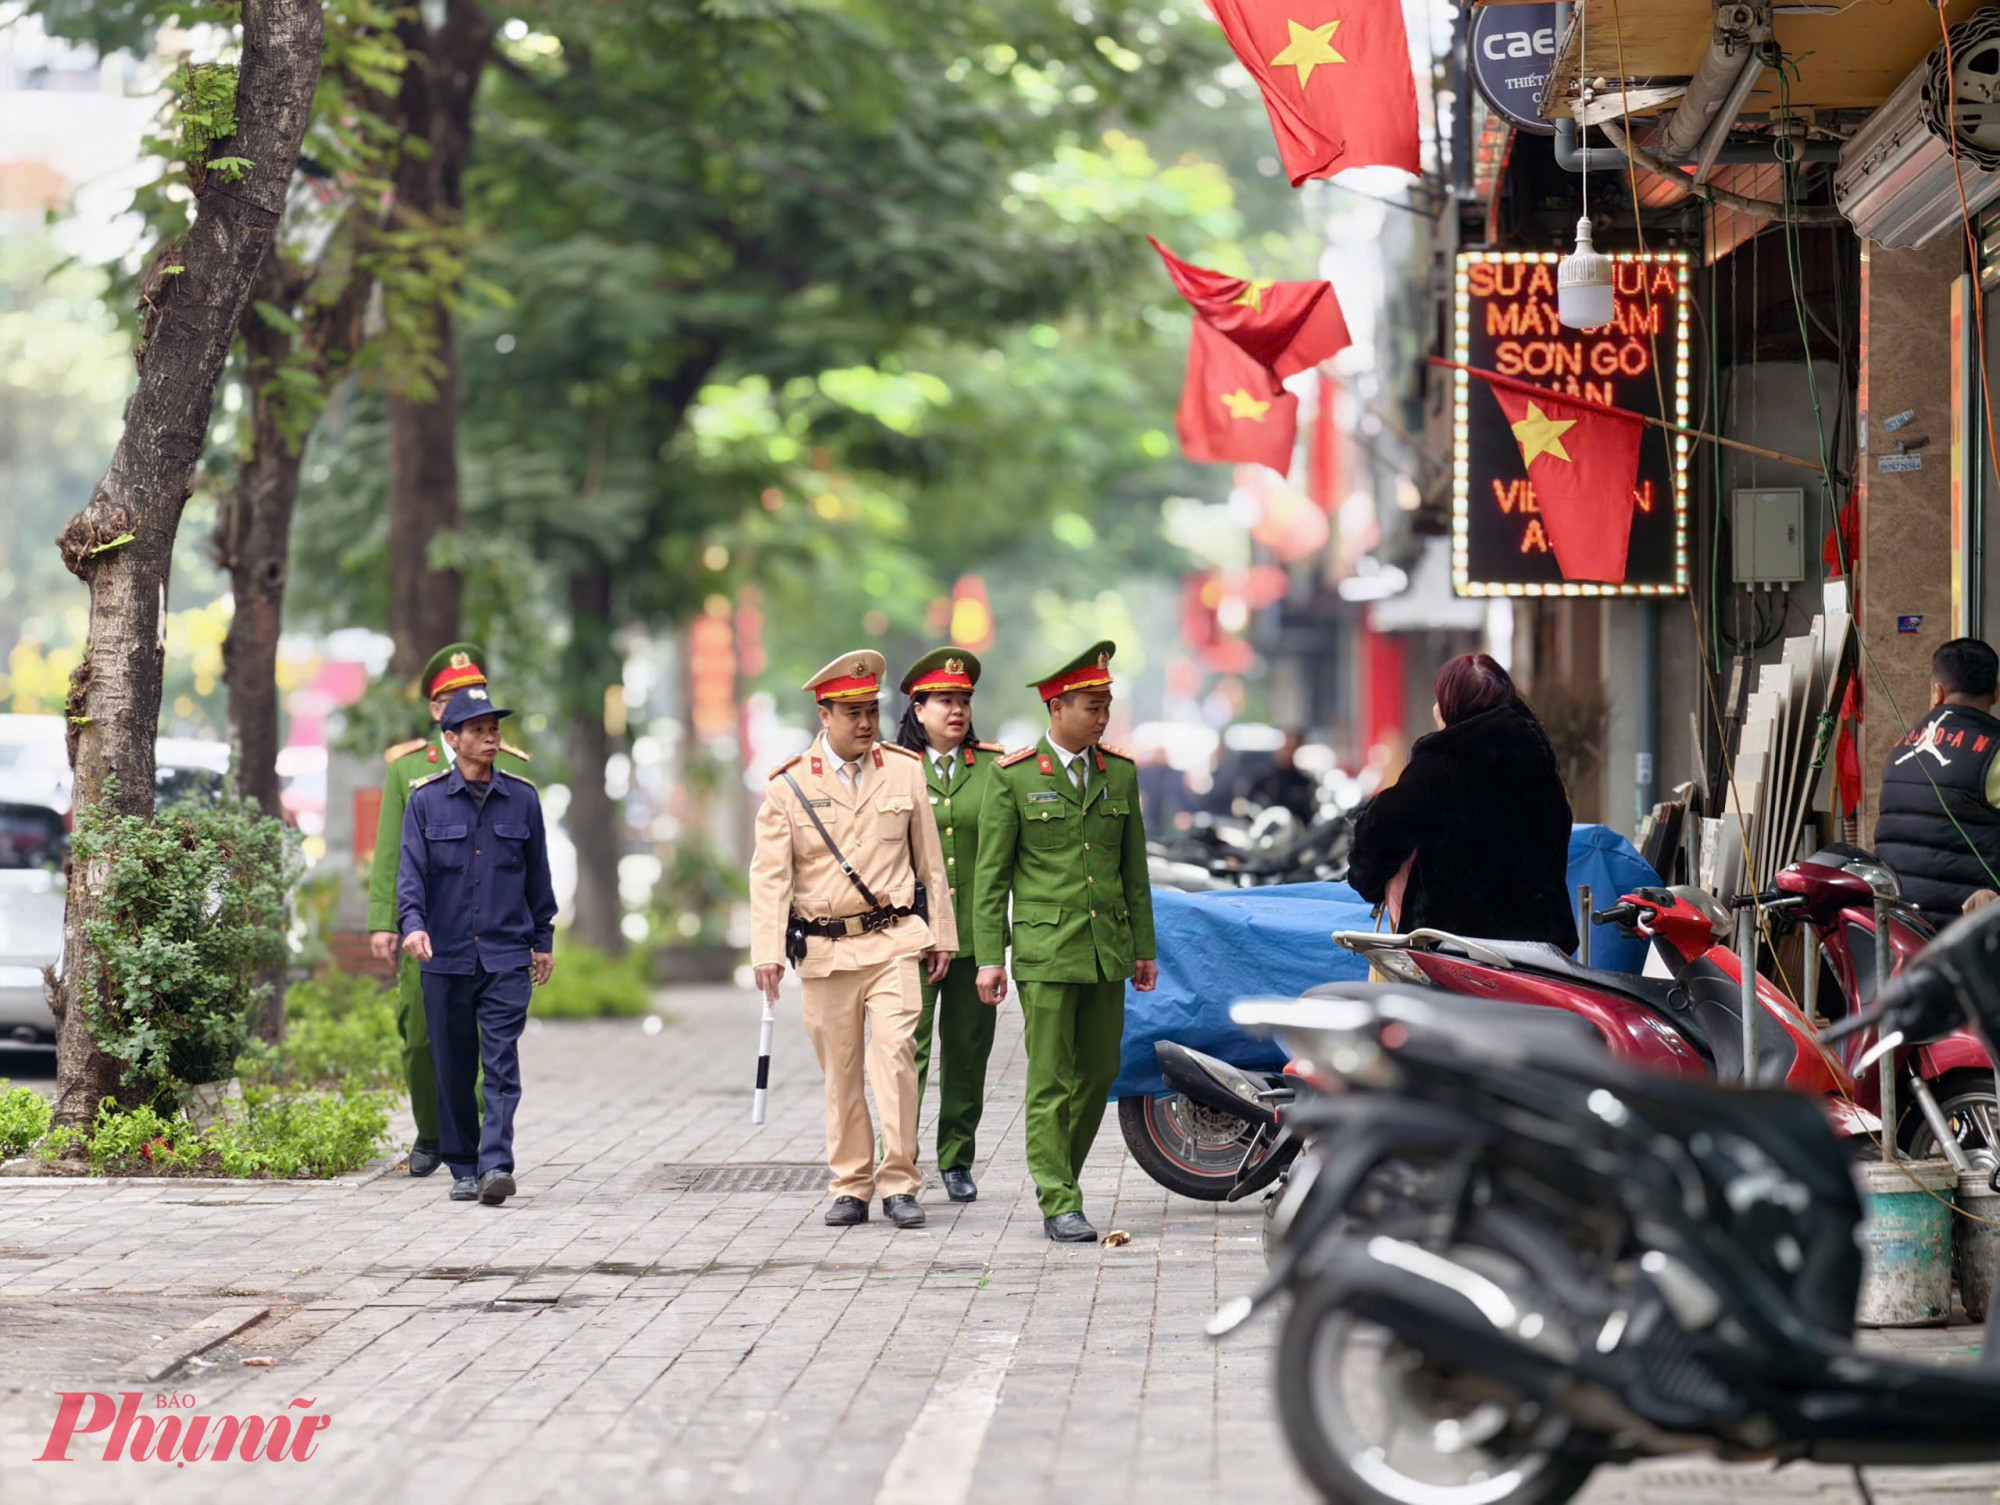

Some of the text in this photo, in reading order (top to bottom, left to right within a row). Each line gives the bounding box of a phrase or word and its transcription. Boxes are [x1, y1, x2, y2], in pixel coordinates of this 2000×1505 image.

[1483, 28, 1555, 60] cae
[1505, 72, 1545, 90] THIẾT
[1496, 341, 1582, 375] SƠN
